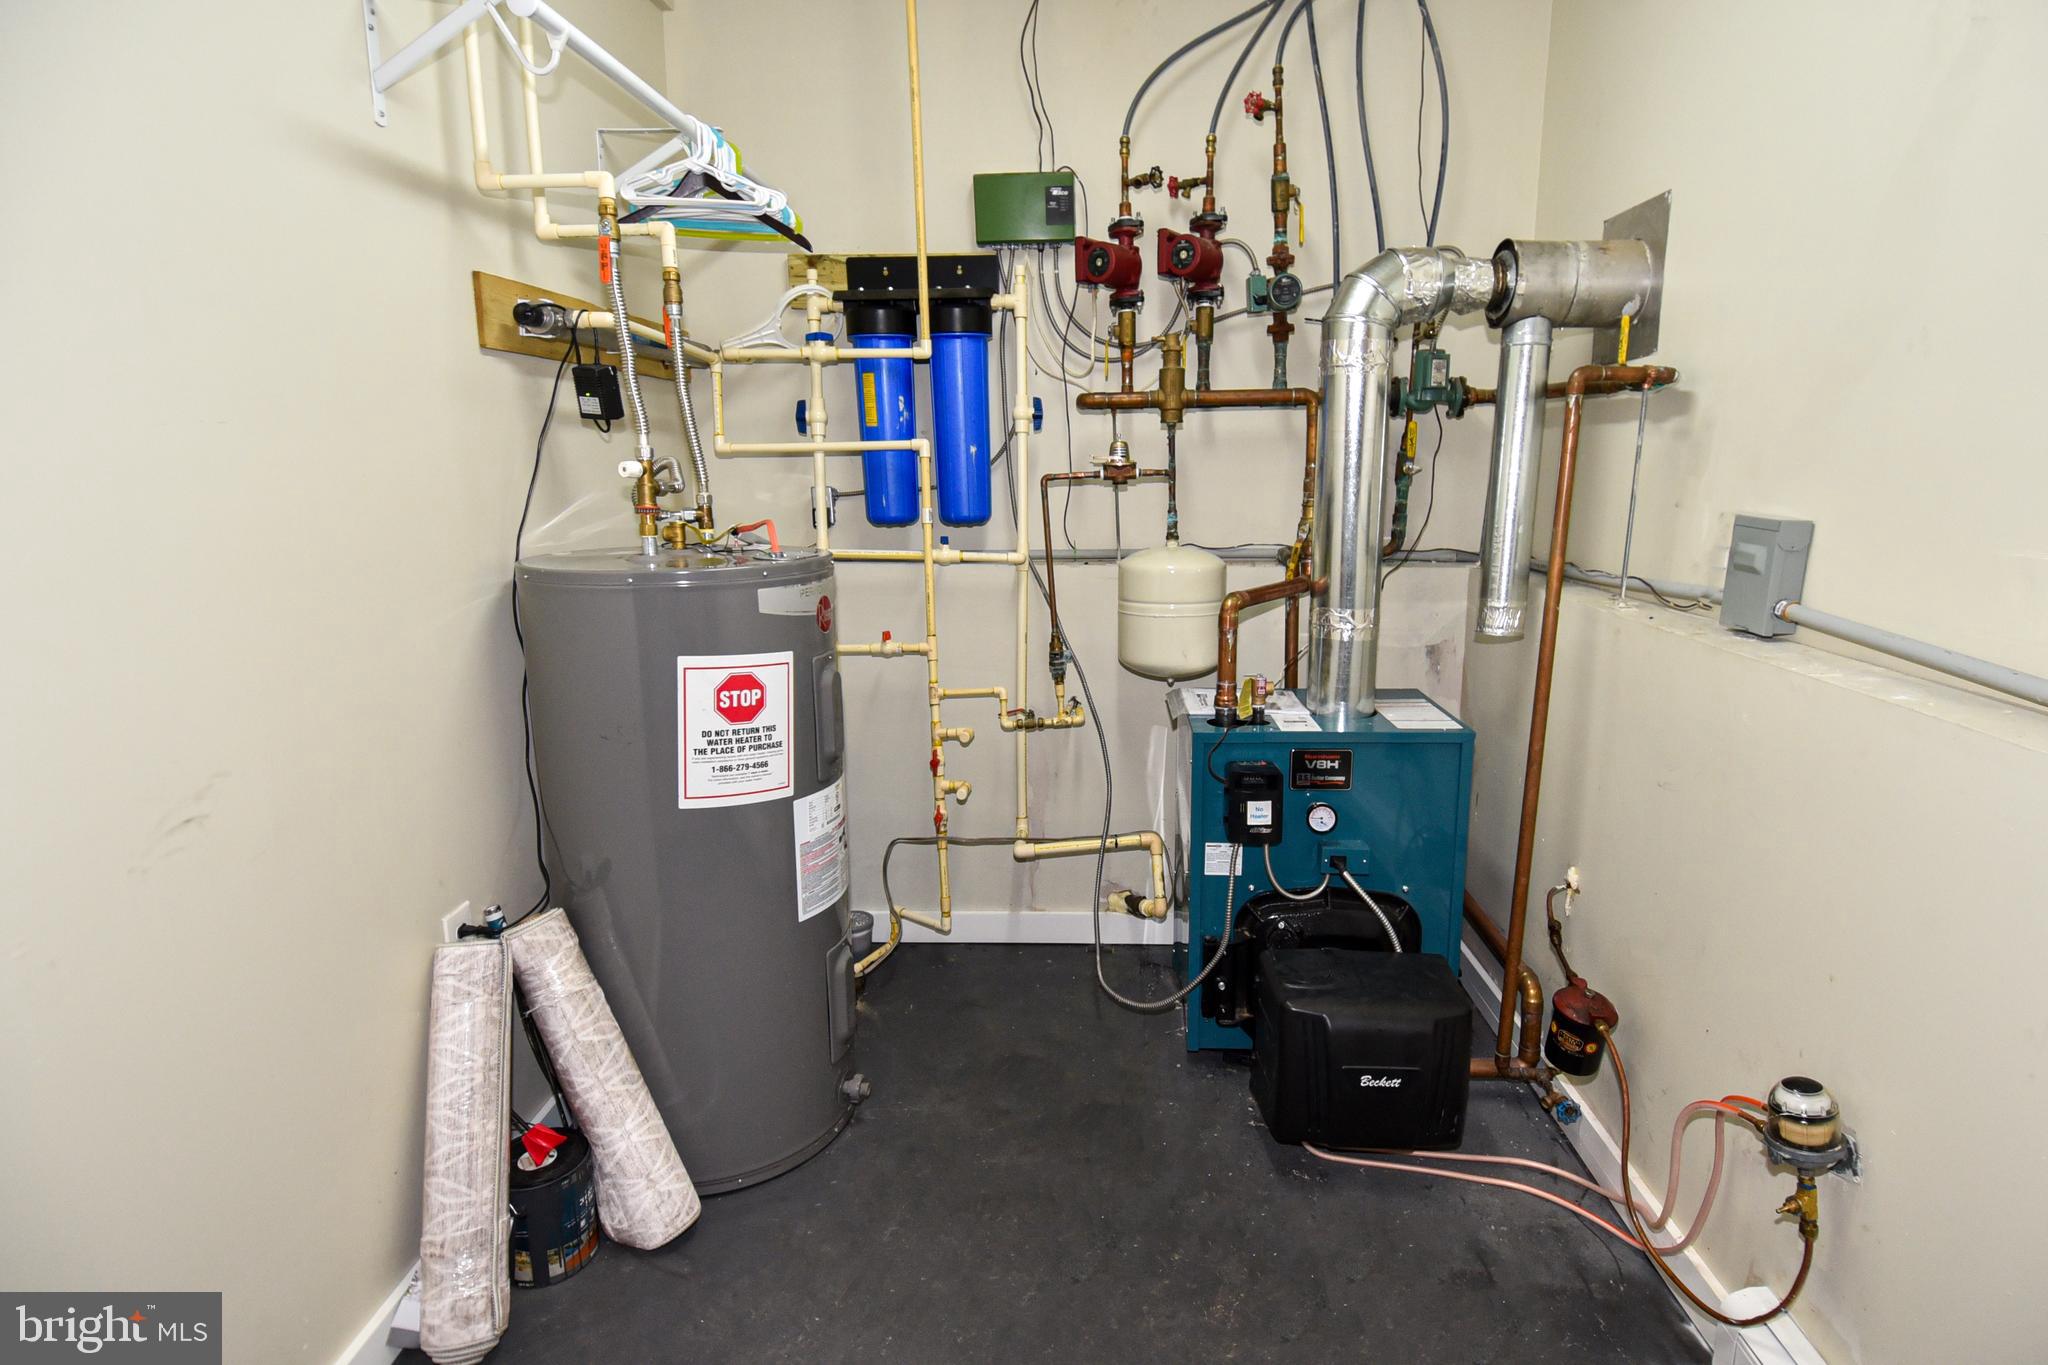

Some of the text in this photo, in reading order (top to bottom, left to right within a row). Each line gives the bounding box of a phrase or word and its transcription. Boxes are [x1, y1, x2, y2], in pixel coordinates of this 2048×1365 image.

[719, 688, 762, 708] STOP
[701, 724, 777, 738] DO NOT RETURN THIS
[706, 733, 773, 747] WATER HEATER TO
[693, 748, 708, 756] THE
[710, 746, 735, 755] PLACE
[737, 745, 746, 753] OF
[748, 740, 783, 752] PURCHASE
[711, 760, 769, 773] 1-866-279-4566
[1304, 759, 1339, 769] V8H
[1360, 1075, 1402, 1087] Beckett
